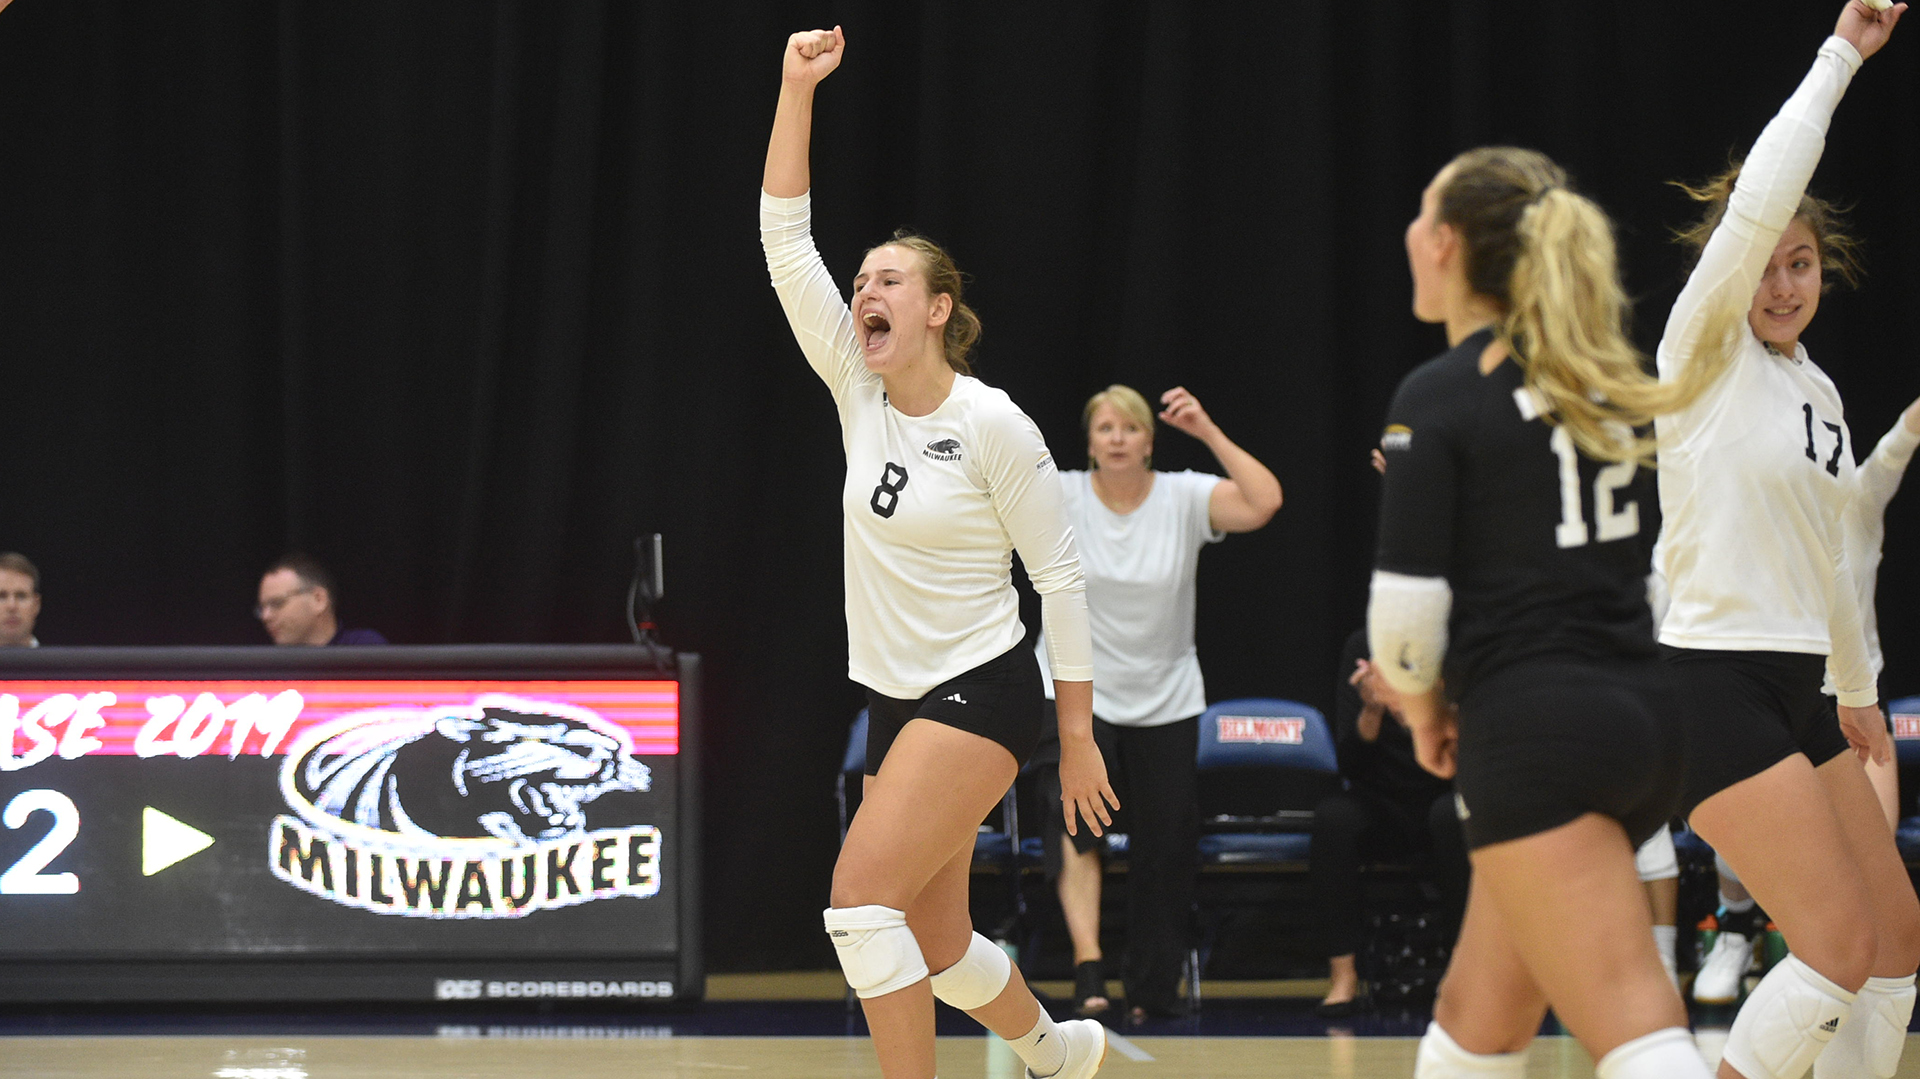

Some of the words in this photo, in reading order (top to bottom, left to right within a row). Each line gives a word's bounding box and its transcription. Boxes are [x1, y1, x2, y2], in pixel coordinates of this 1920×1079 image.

[922, 449, 962, 462] MILWAUKEE
[1802, 402, 1843, 478] 17
[870, 461, 909, 519] 8
[1550, 422, 1640, 548] 12
[134, 689, 304, 761] 2019
[1217, 715, 1305, 744] BELMONT
[0, 788, 81, 895] 2
[275, 823, 657, 914] MILWAUKEE
[487, 981, 674, 998] SCOREBOARDS
